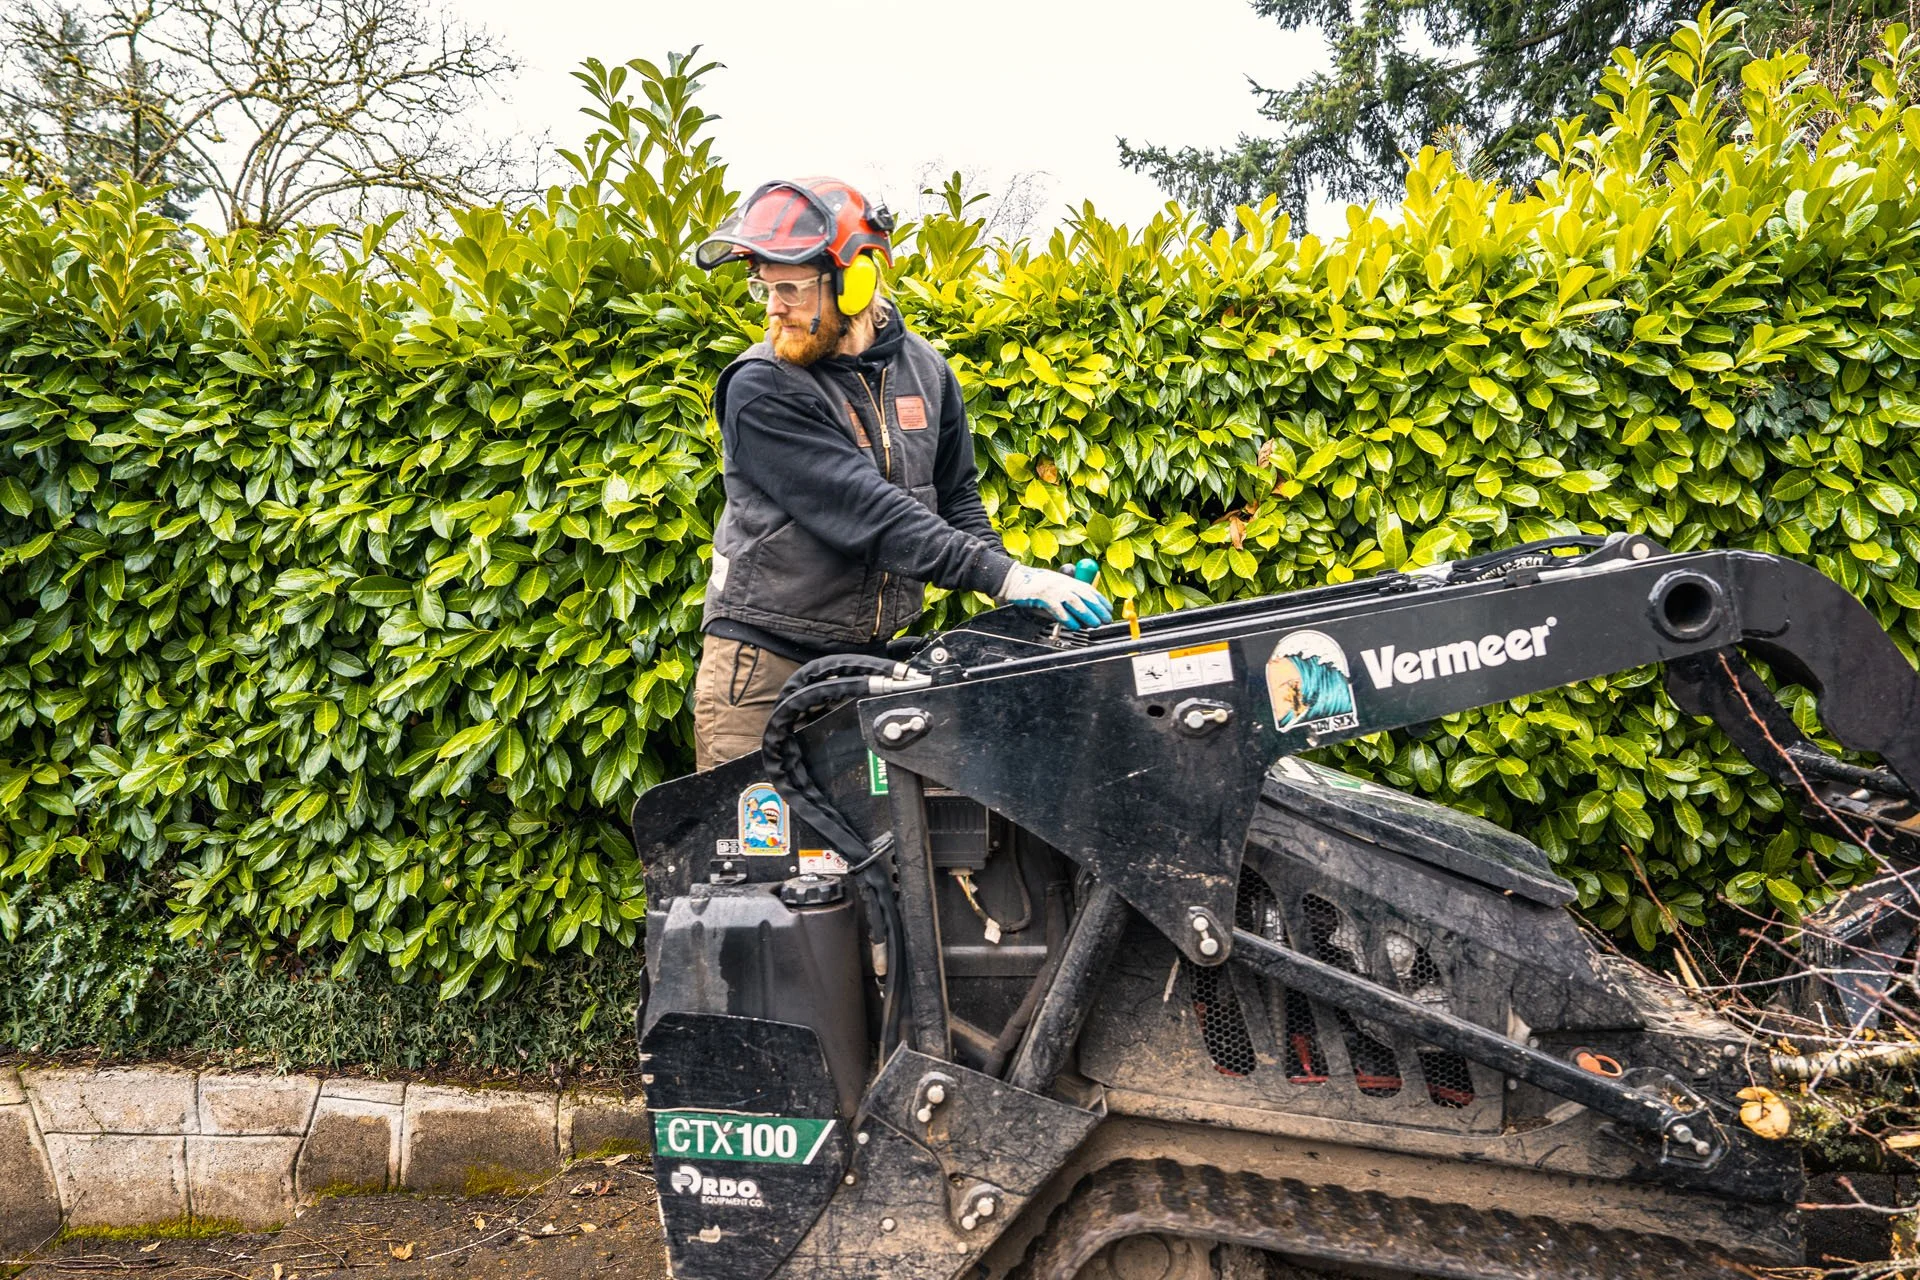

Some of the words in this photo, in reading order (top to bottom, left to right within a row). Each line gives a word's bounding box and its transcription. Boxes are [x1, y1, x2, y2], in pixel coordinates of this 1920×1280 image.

[1360, 624, 1551, 690] Vermeer
[668, 1118, 798, 1158] CTX100
[700, 1196, 748, 1206] EQUIPMENT
